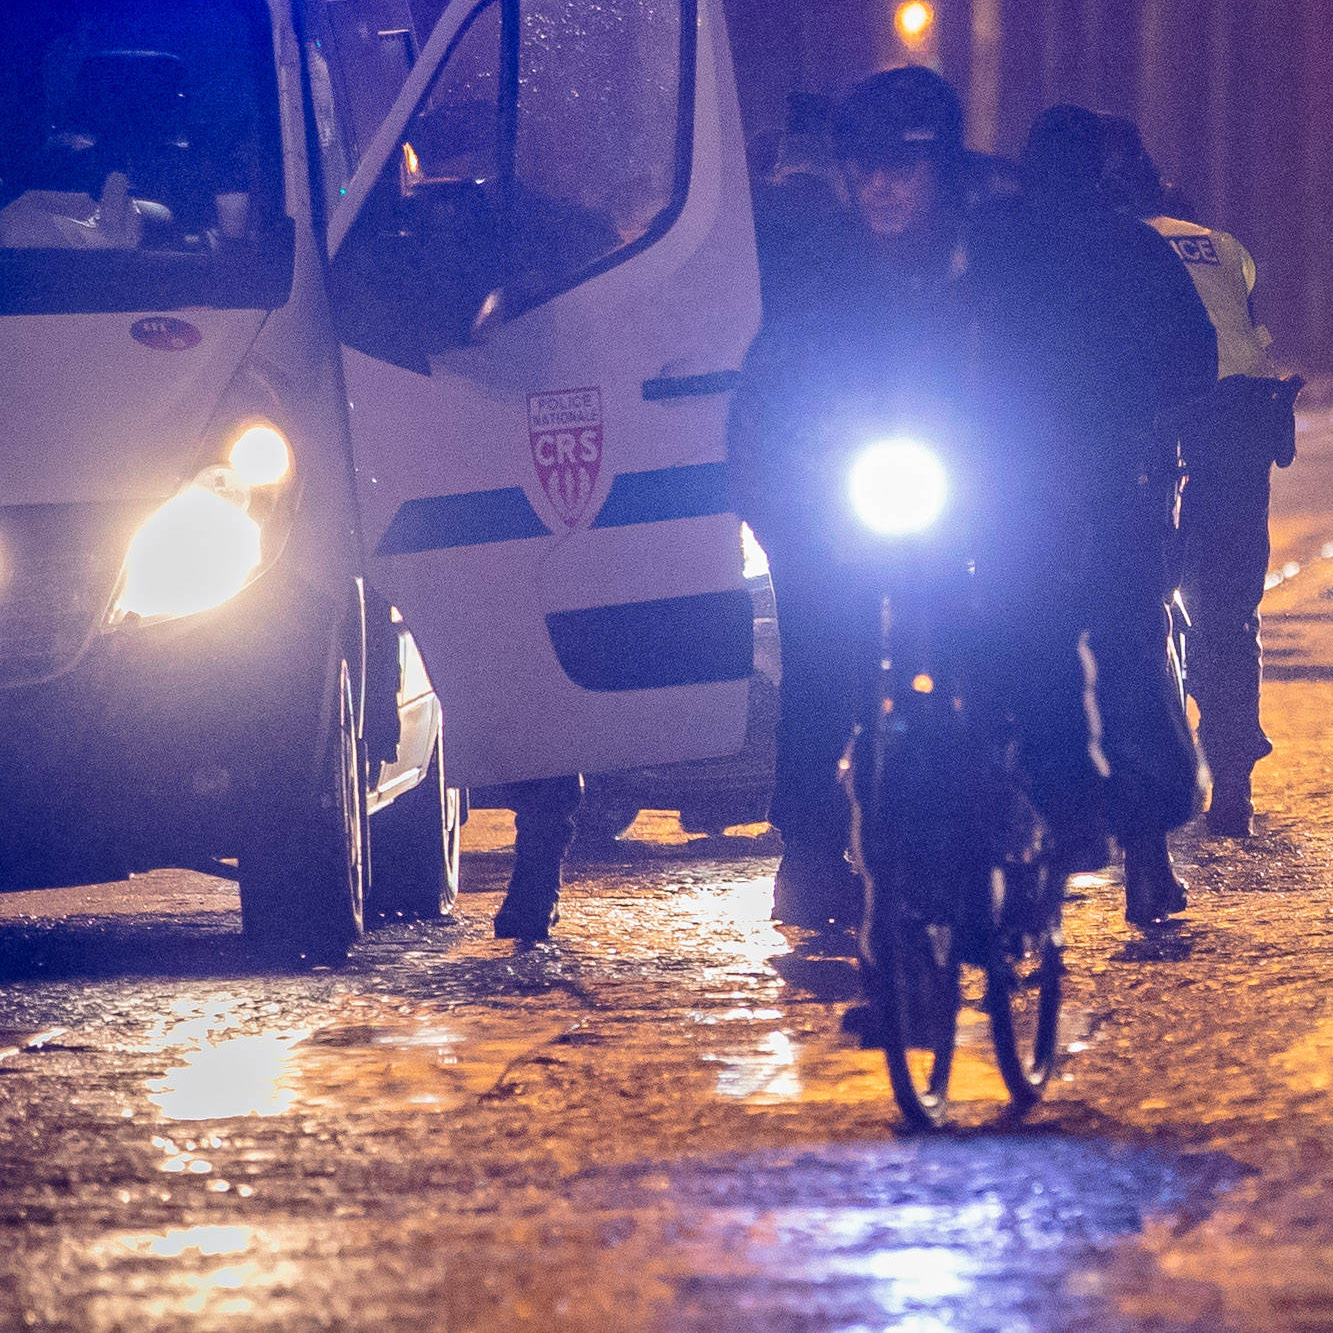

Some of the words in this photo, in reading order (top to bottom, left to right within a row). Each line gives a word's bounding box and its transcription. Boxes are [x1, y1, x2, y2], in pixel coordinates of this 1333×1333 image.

[1168, 238, 1218, 263] ICE
[538, 393, 592, 410] POLICE
[535, 429, 599, 466] CRS
